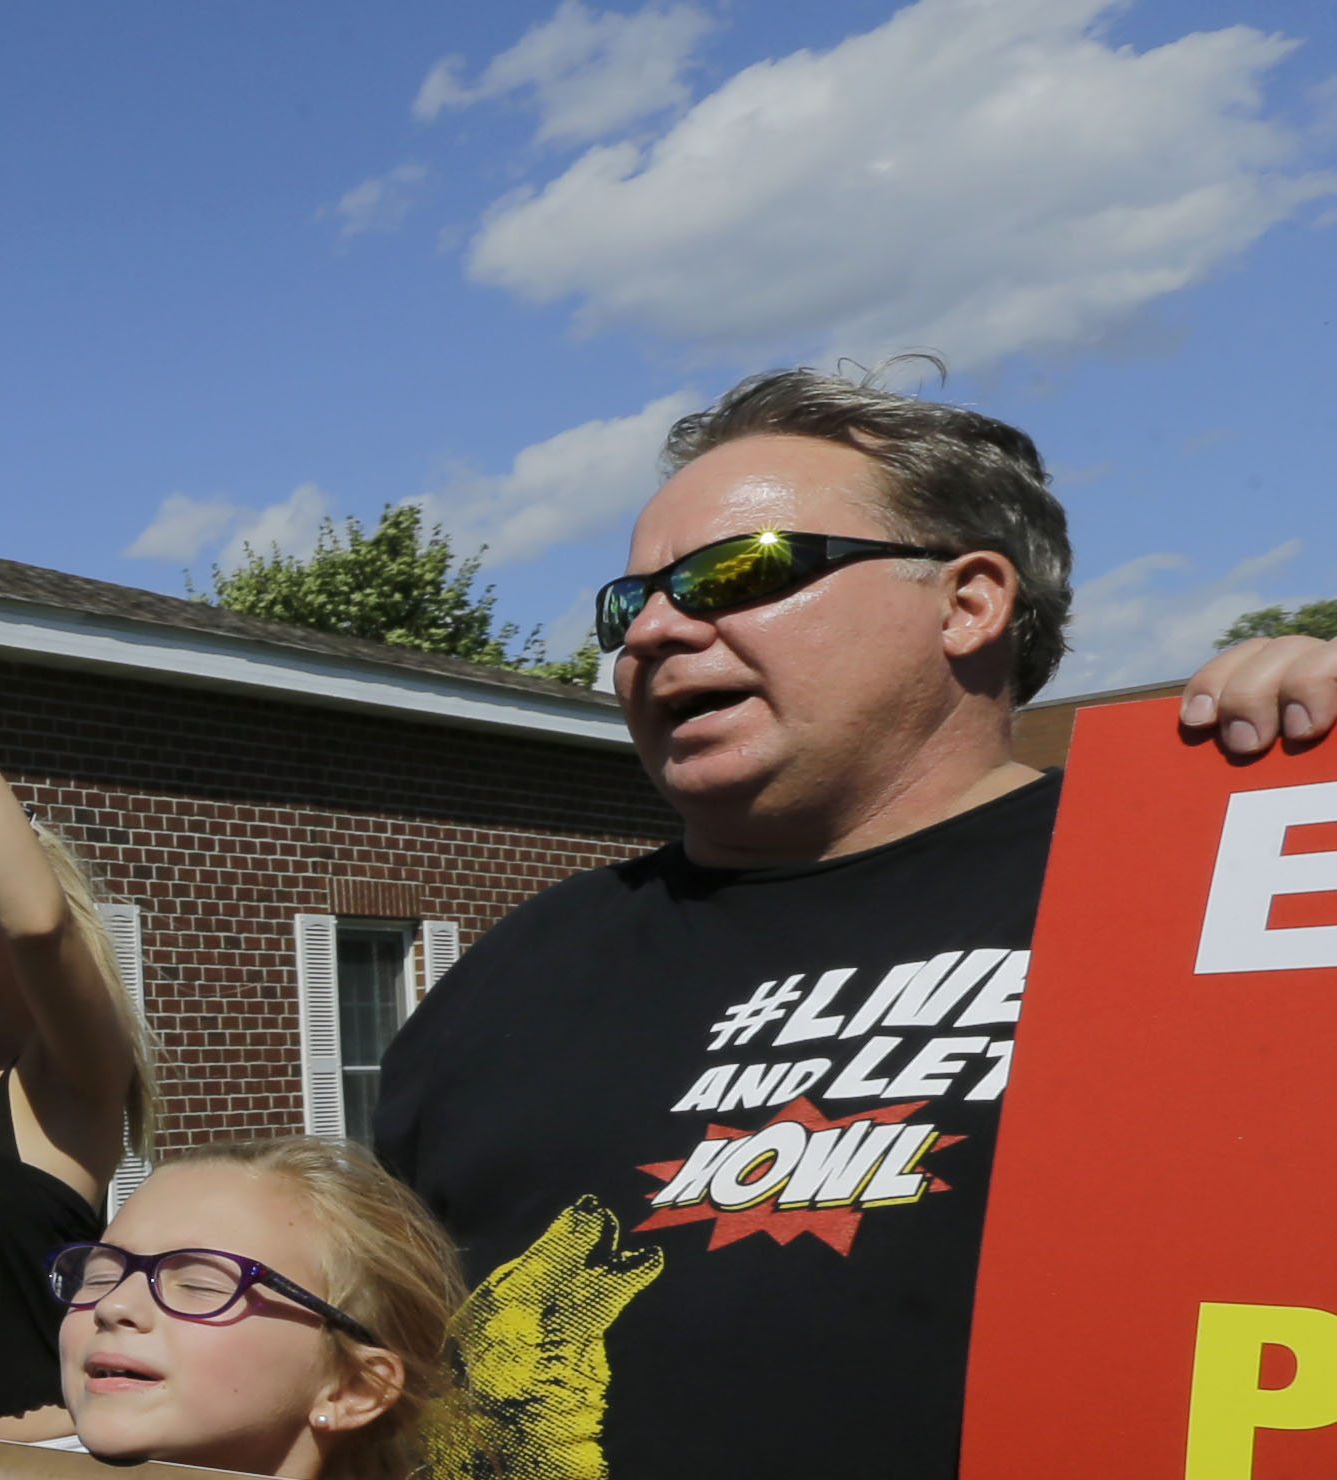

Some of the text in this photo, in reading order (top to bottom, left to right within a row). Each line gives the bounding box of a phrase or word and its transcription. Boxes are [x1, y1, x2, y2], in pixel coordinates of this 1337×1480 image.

[670, 1036, 1015, 1113] AND LET
[651, 1119, 940, 1210] HOWL
